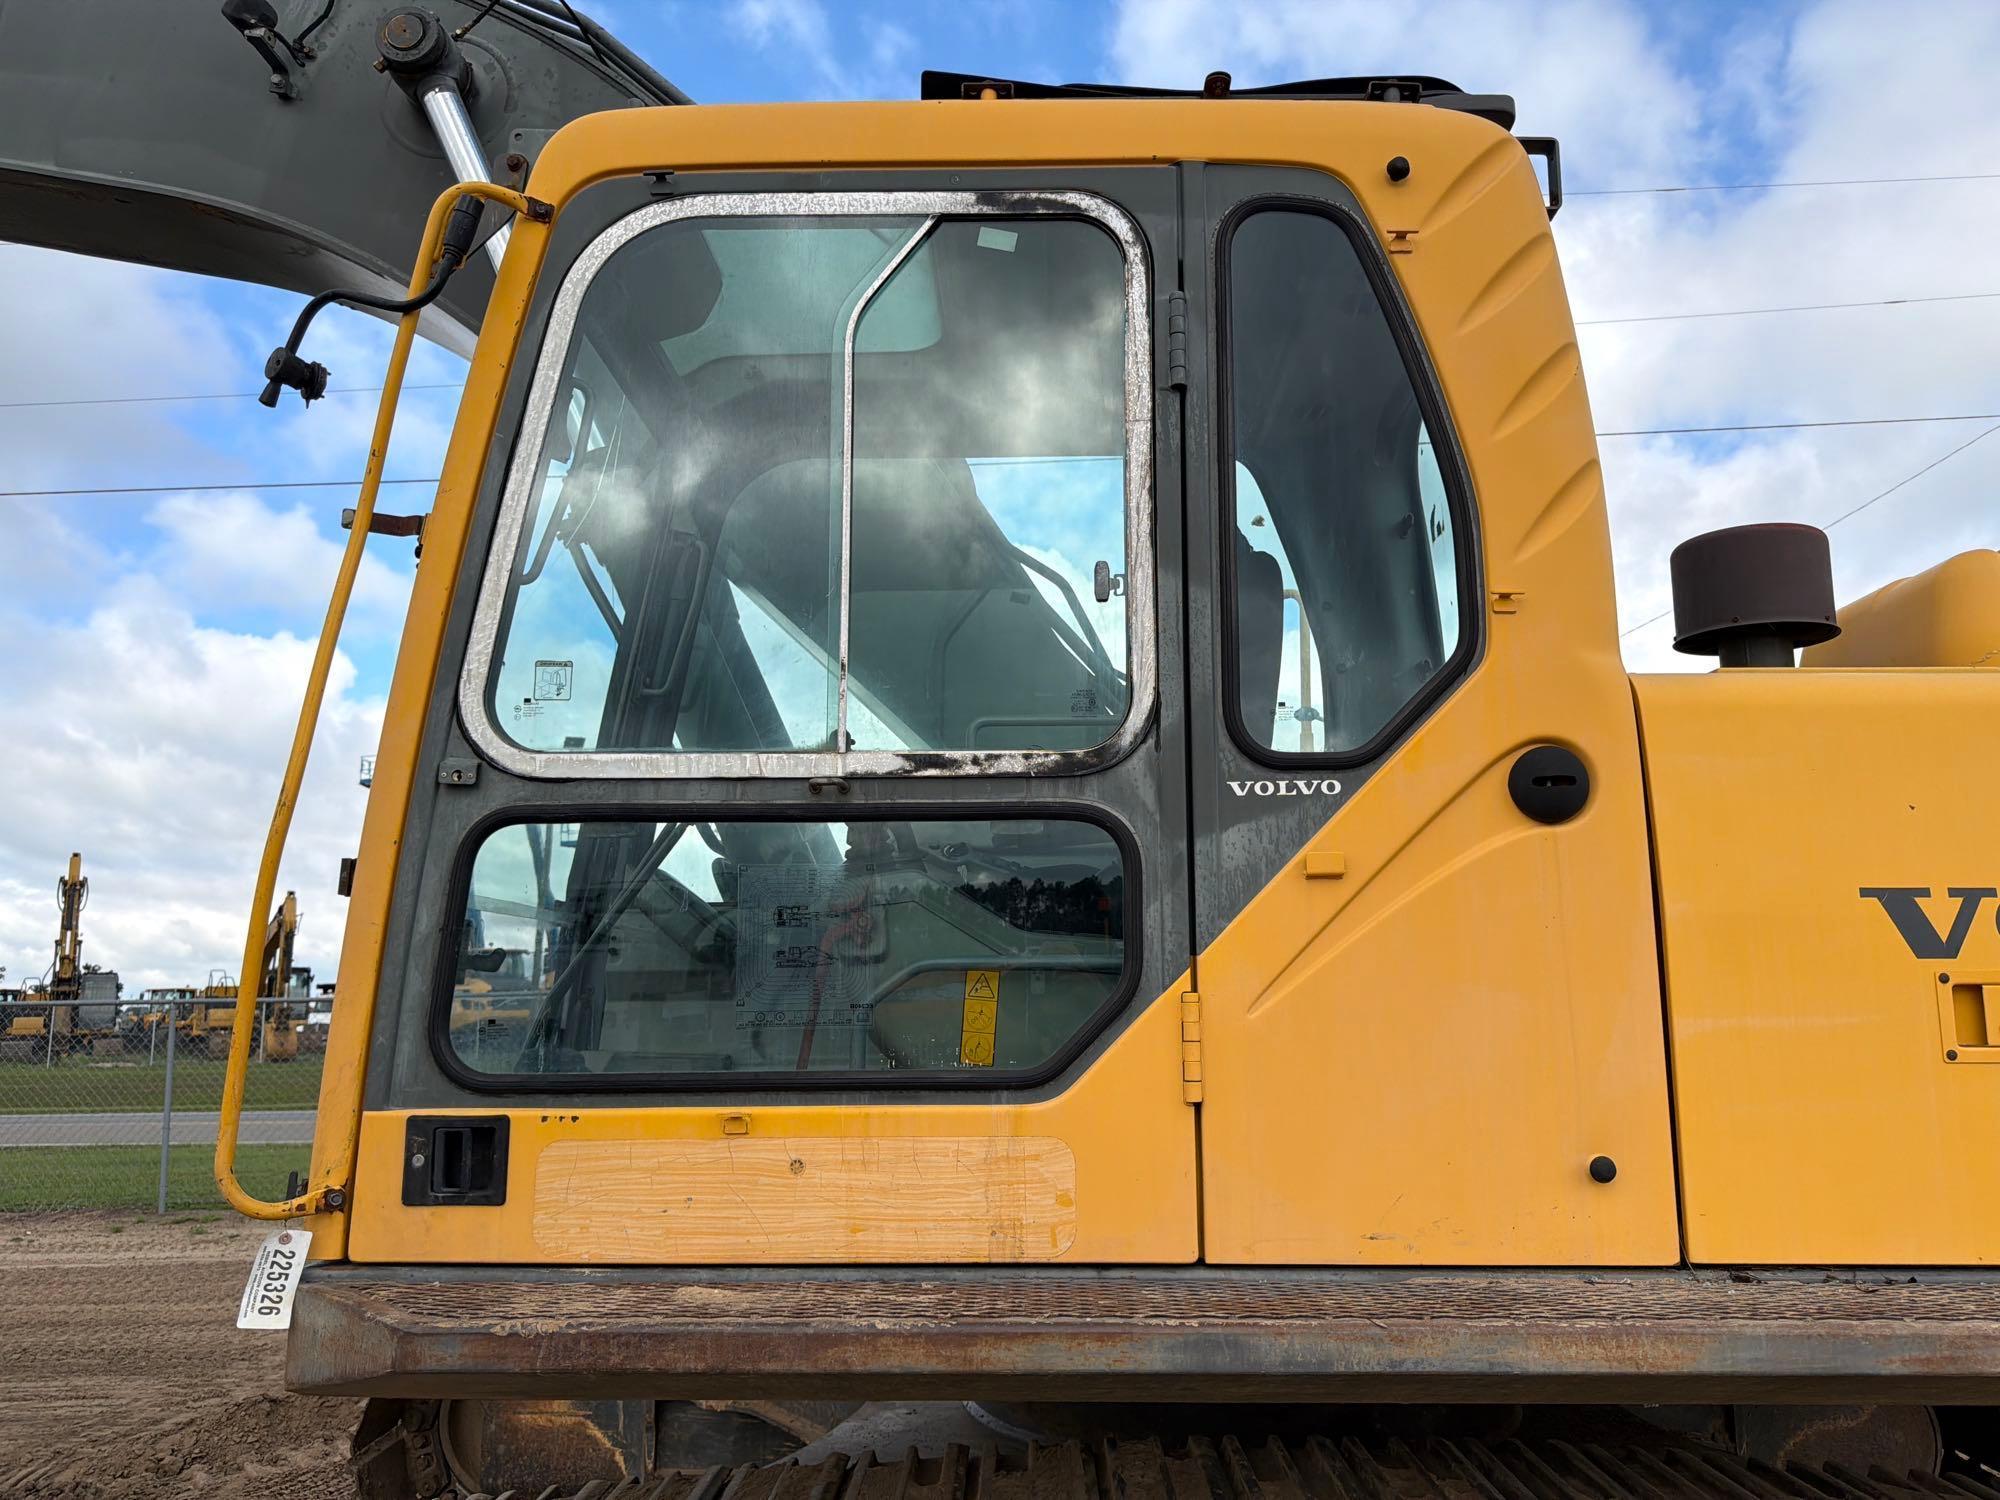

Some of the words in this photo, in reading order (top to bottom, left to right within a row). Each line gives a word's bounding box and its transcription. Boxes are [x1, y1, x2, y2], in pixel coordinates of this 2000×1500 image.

[1226, 779, 1342, 797] VOLVO
[1858, 886, 2000, 960] V
[257, 1249, 296, 1316] 225326
